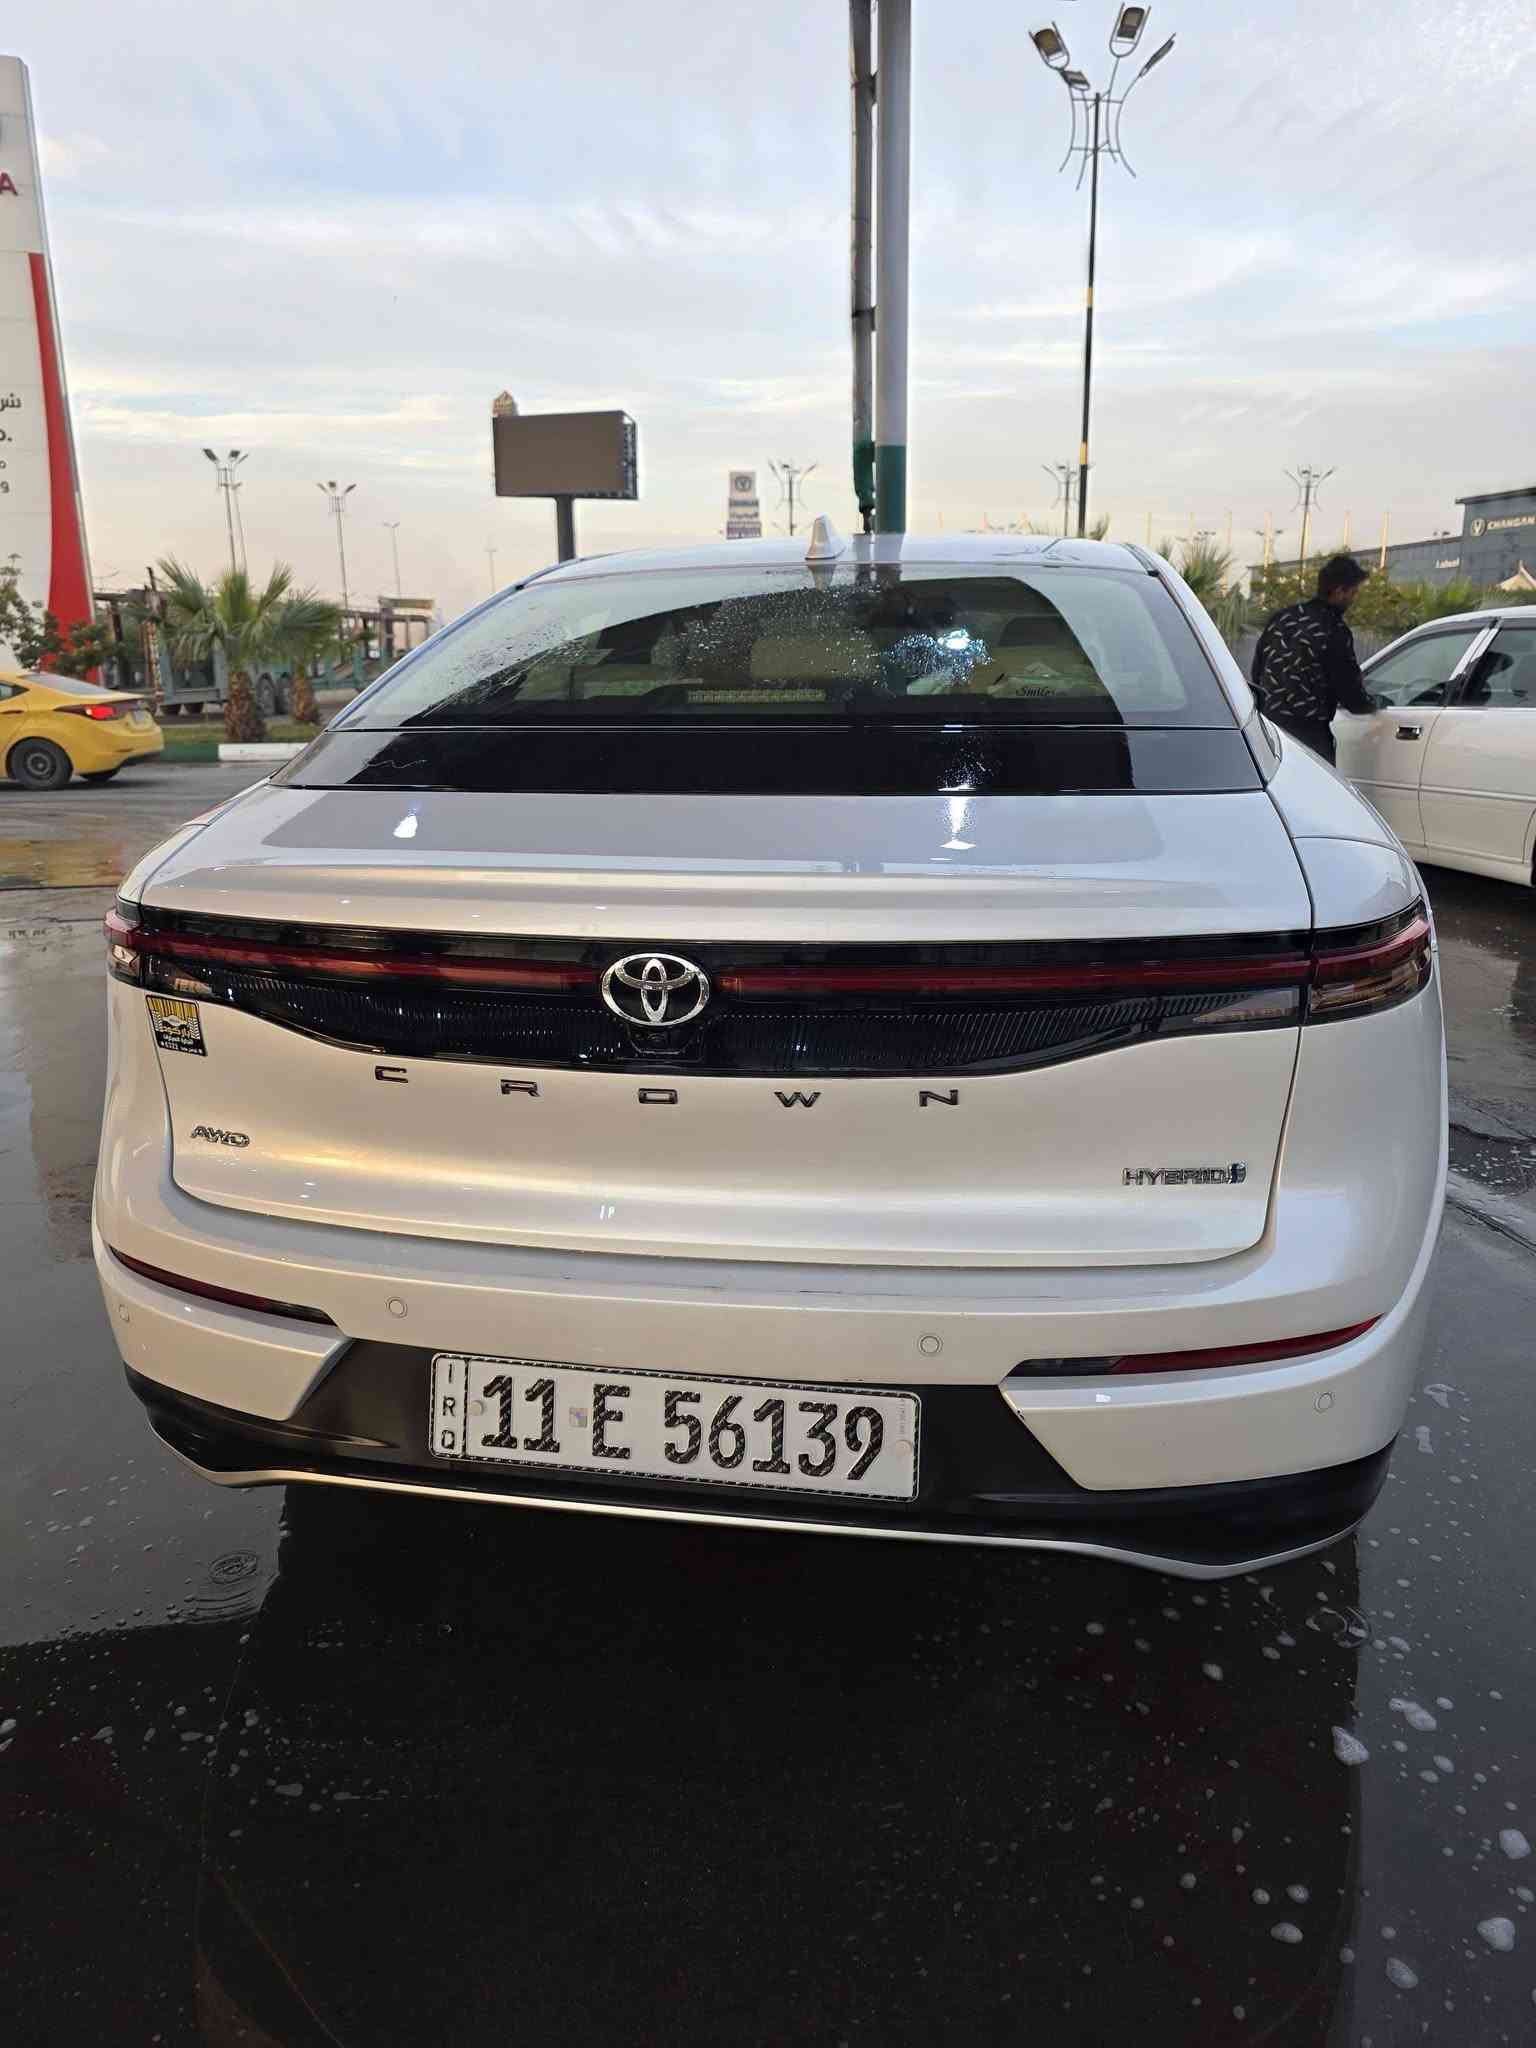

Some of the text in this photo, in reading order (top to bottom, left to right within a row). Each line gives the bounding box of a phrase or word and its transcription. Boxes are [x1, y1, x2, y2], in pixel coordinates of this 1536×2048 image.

[375, 1065, 958, 1108] CROWN
[191, 1126, 250, 1148] AWD
[1123, 1167, 1227, 1186] HYBRID
[481, 1375, 560, 1453] 11
[592, 1384, 631, 1459] E
[664, 1390, 885, 1481] 56139
